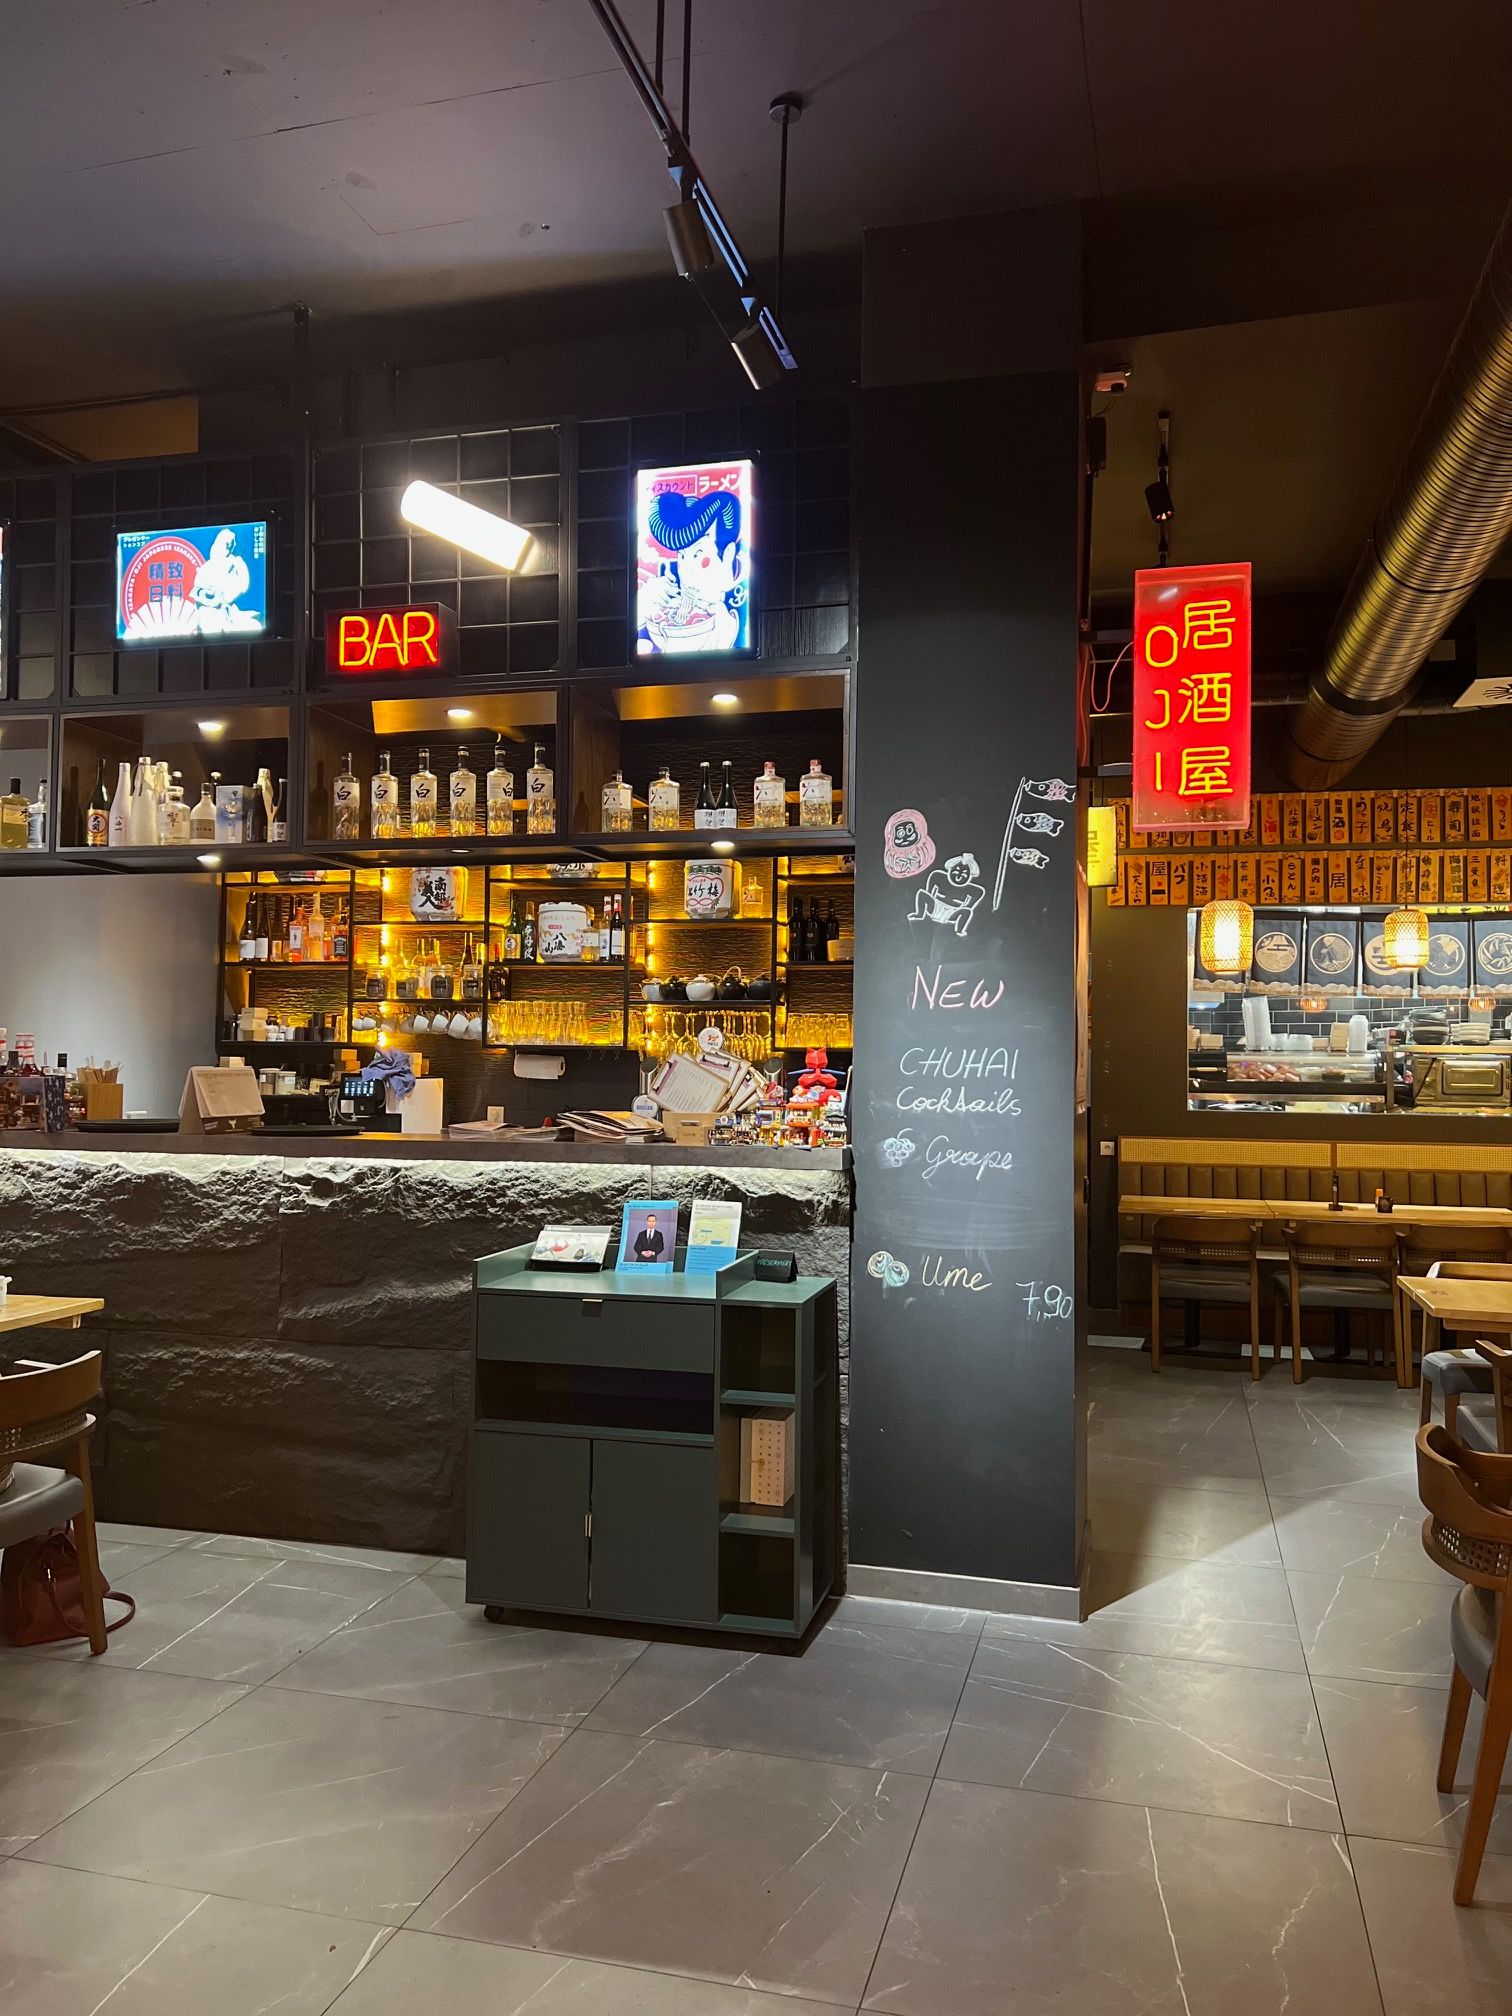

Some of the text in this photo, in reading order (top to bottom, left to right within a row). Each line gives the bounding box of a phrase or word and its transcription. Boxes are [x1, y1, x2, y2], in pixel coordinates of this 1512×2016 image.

[699, 473, 740, 493] ラーメン
[143, 544, 173, 562] JAPANESE
[340, 611, 437, 666] BAR
[1145, 625, 1179, 791] OJI
[1178, 599, 1236, 795] 居酒屋
[1313, 799, 1322, 830] ラーメン
[1330, 872, 1346, 889] 居
[911, 964, 1005, 1010] NEW
[900, 1046, 1019, 1079] CHUHAI
[896, 1086, 1022, 1116] Cocktails
[922, 1135, 1014, 1181] Grape
[922, 1255, 993, 1292] Ume
[1015, 1281, 1074, 1322] 7,90
